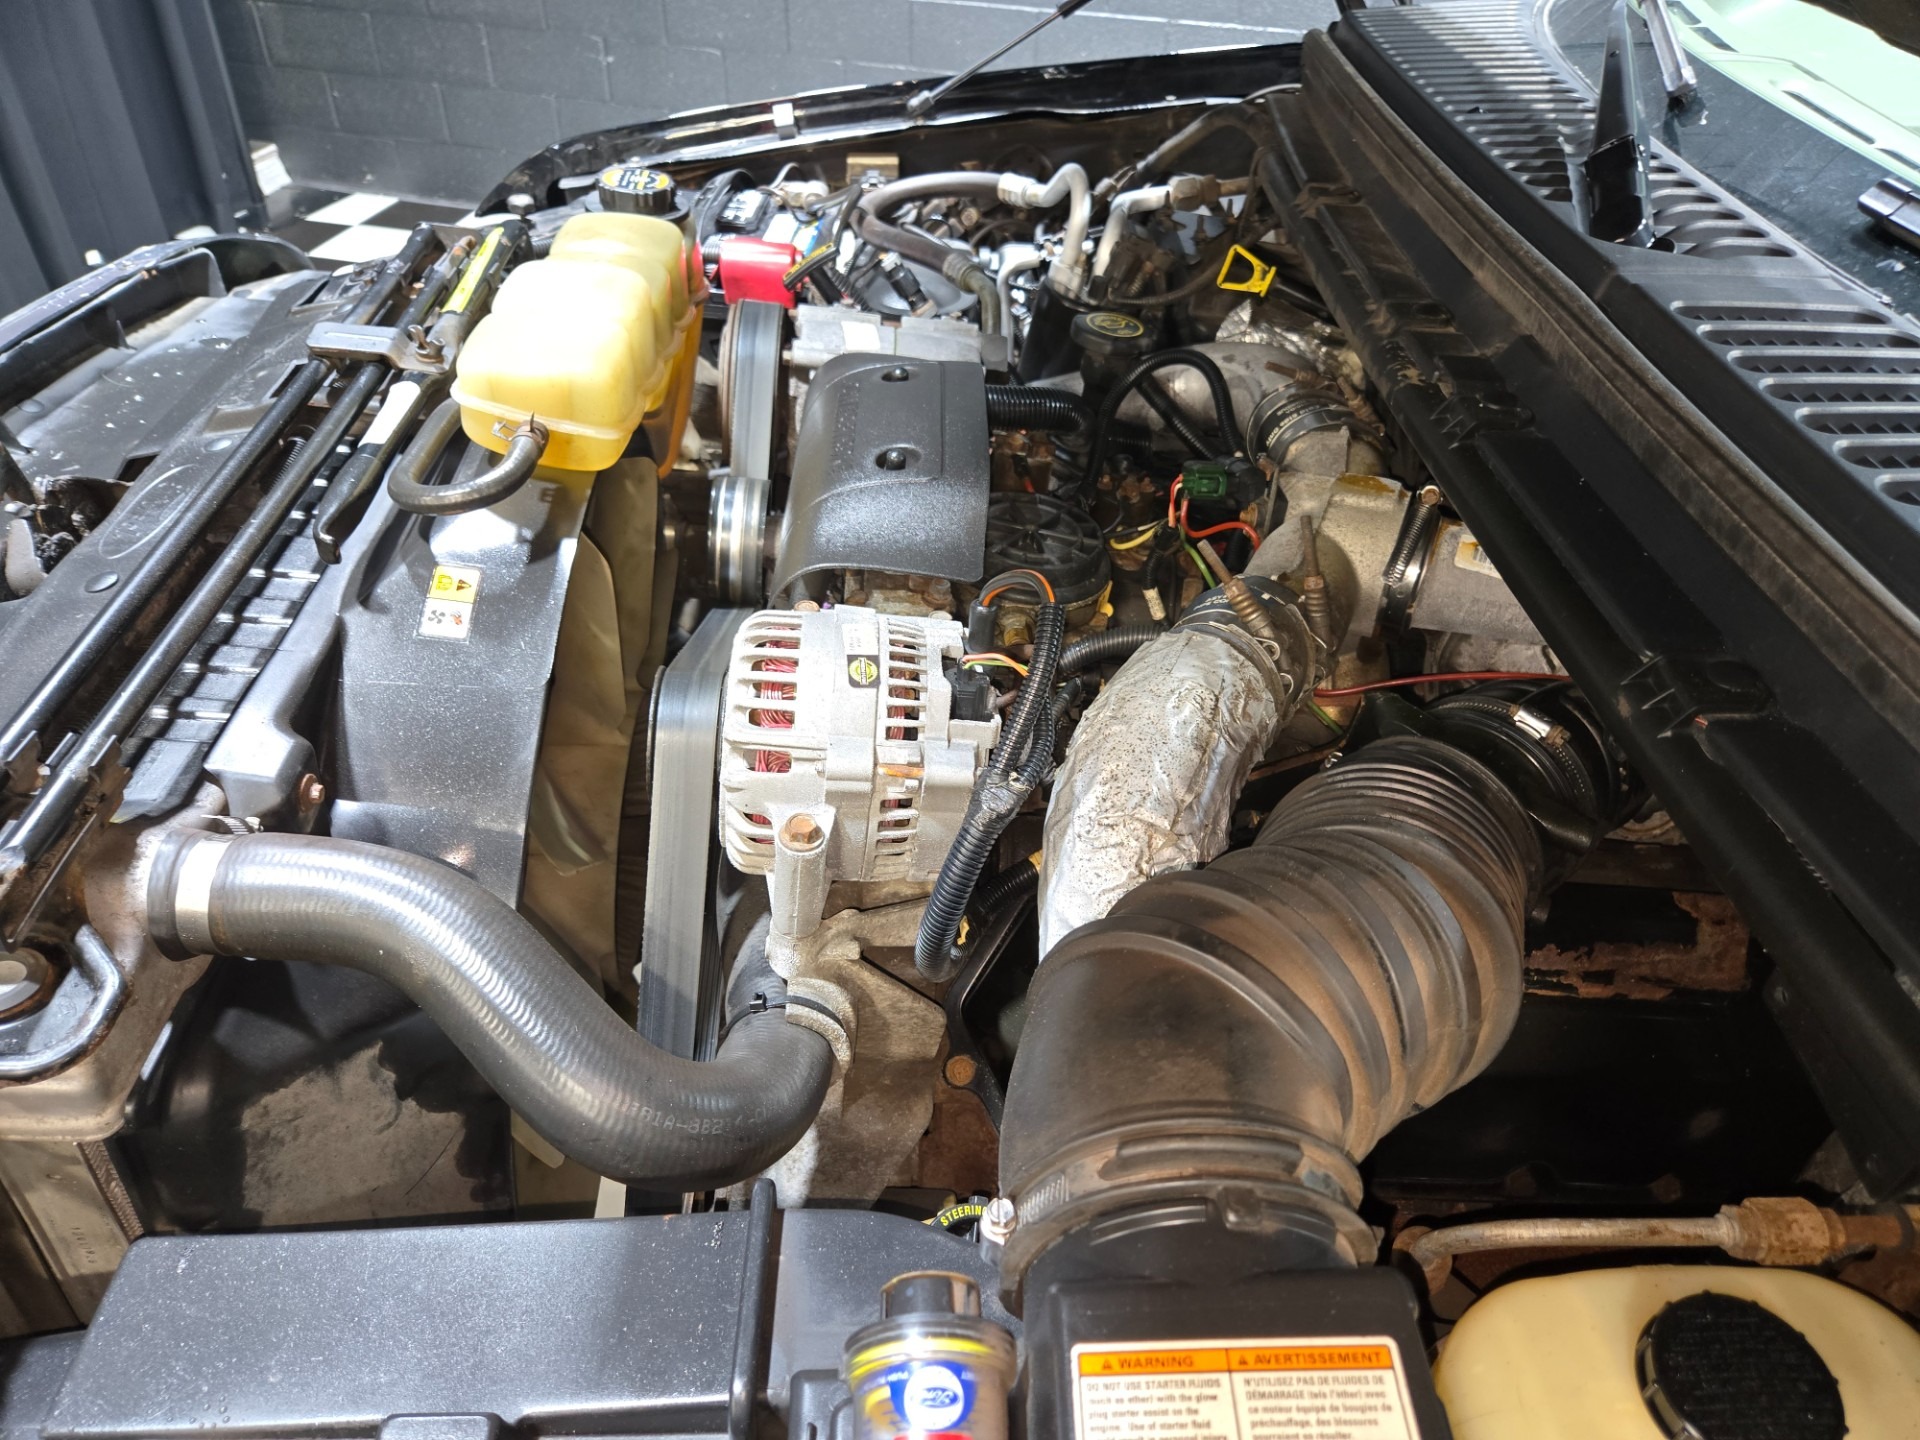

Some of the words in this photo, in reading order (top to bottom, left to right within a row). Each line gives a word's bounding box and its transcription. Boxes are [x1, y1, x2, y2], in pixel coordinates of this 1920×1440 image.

[1118, 1355, 1194, 1369] WARNING
[1254, 1351, 1382, 1365] AVERTISSEMENT
[1103, 1381, 1121, 1391] NOT
[1124, 1381, 1142, 1391] USE
[1145, 1379, 1186, 1390] STARTER
[1188, 1378, 1221, 1389] FLUIDS
[1243, 1376, 1294, 1387] N'UTILISEZ
[1296, 1375, 1315, 1386] PAS
[1317, 1375, 1330, 1386] DE
[1332, 1375, 1370, 1386] FLUIDES
[1372, 1375, 1385, 1385] DE
[1157, 1393, 1176, 1403] with
[1178, 1393, 1192, 1402] the
[1195, 1392, 1218, 1403] glow
[1245, 1388, 1305, 1401] DÉMARRAGE
[1365, 1391, 1386, 1399] avec
[1111, 1410, 1139, 1418] starter
[1143, 1408, 1169, 1417] assist
[1185, 1406, 1199, 1415] the
[1261, 1405, 1292, 1414] moteur
[1295, 1404, 1326, 1415] équipé
[1329, 1403, 1340, 1413] de
[1342, 1403, 1378, 1414] bougies
[1380, 1403, 1392, 1412] de
[1159, 1420, 1189, 1430] starter
[1191, 1419, 1211, 1429] fluid
[1315, 1416, 1331, 1426] des
[1333, 1416, 1379, 1426] blessures
